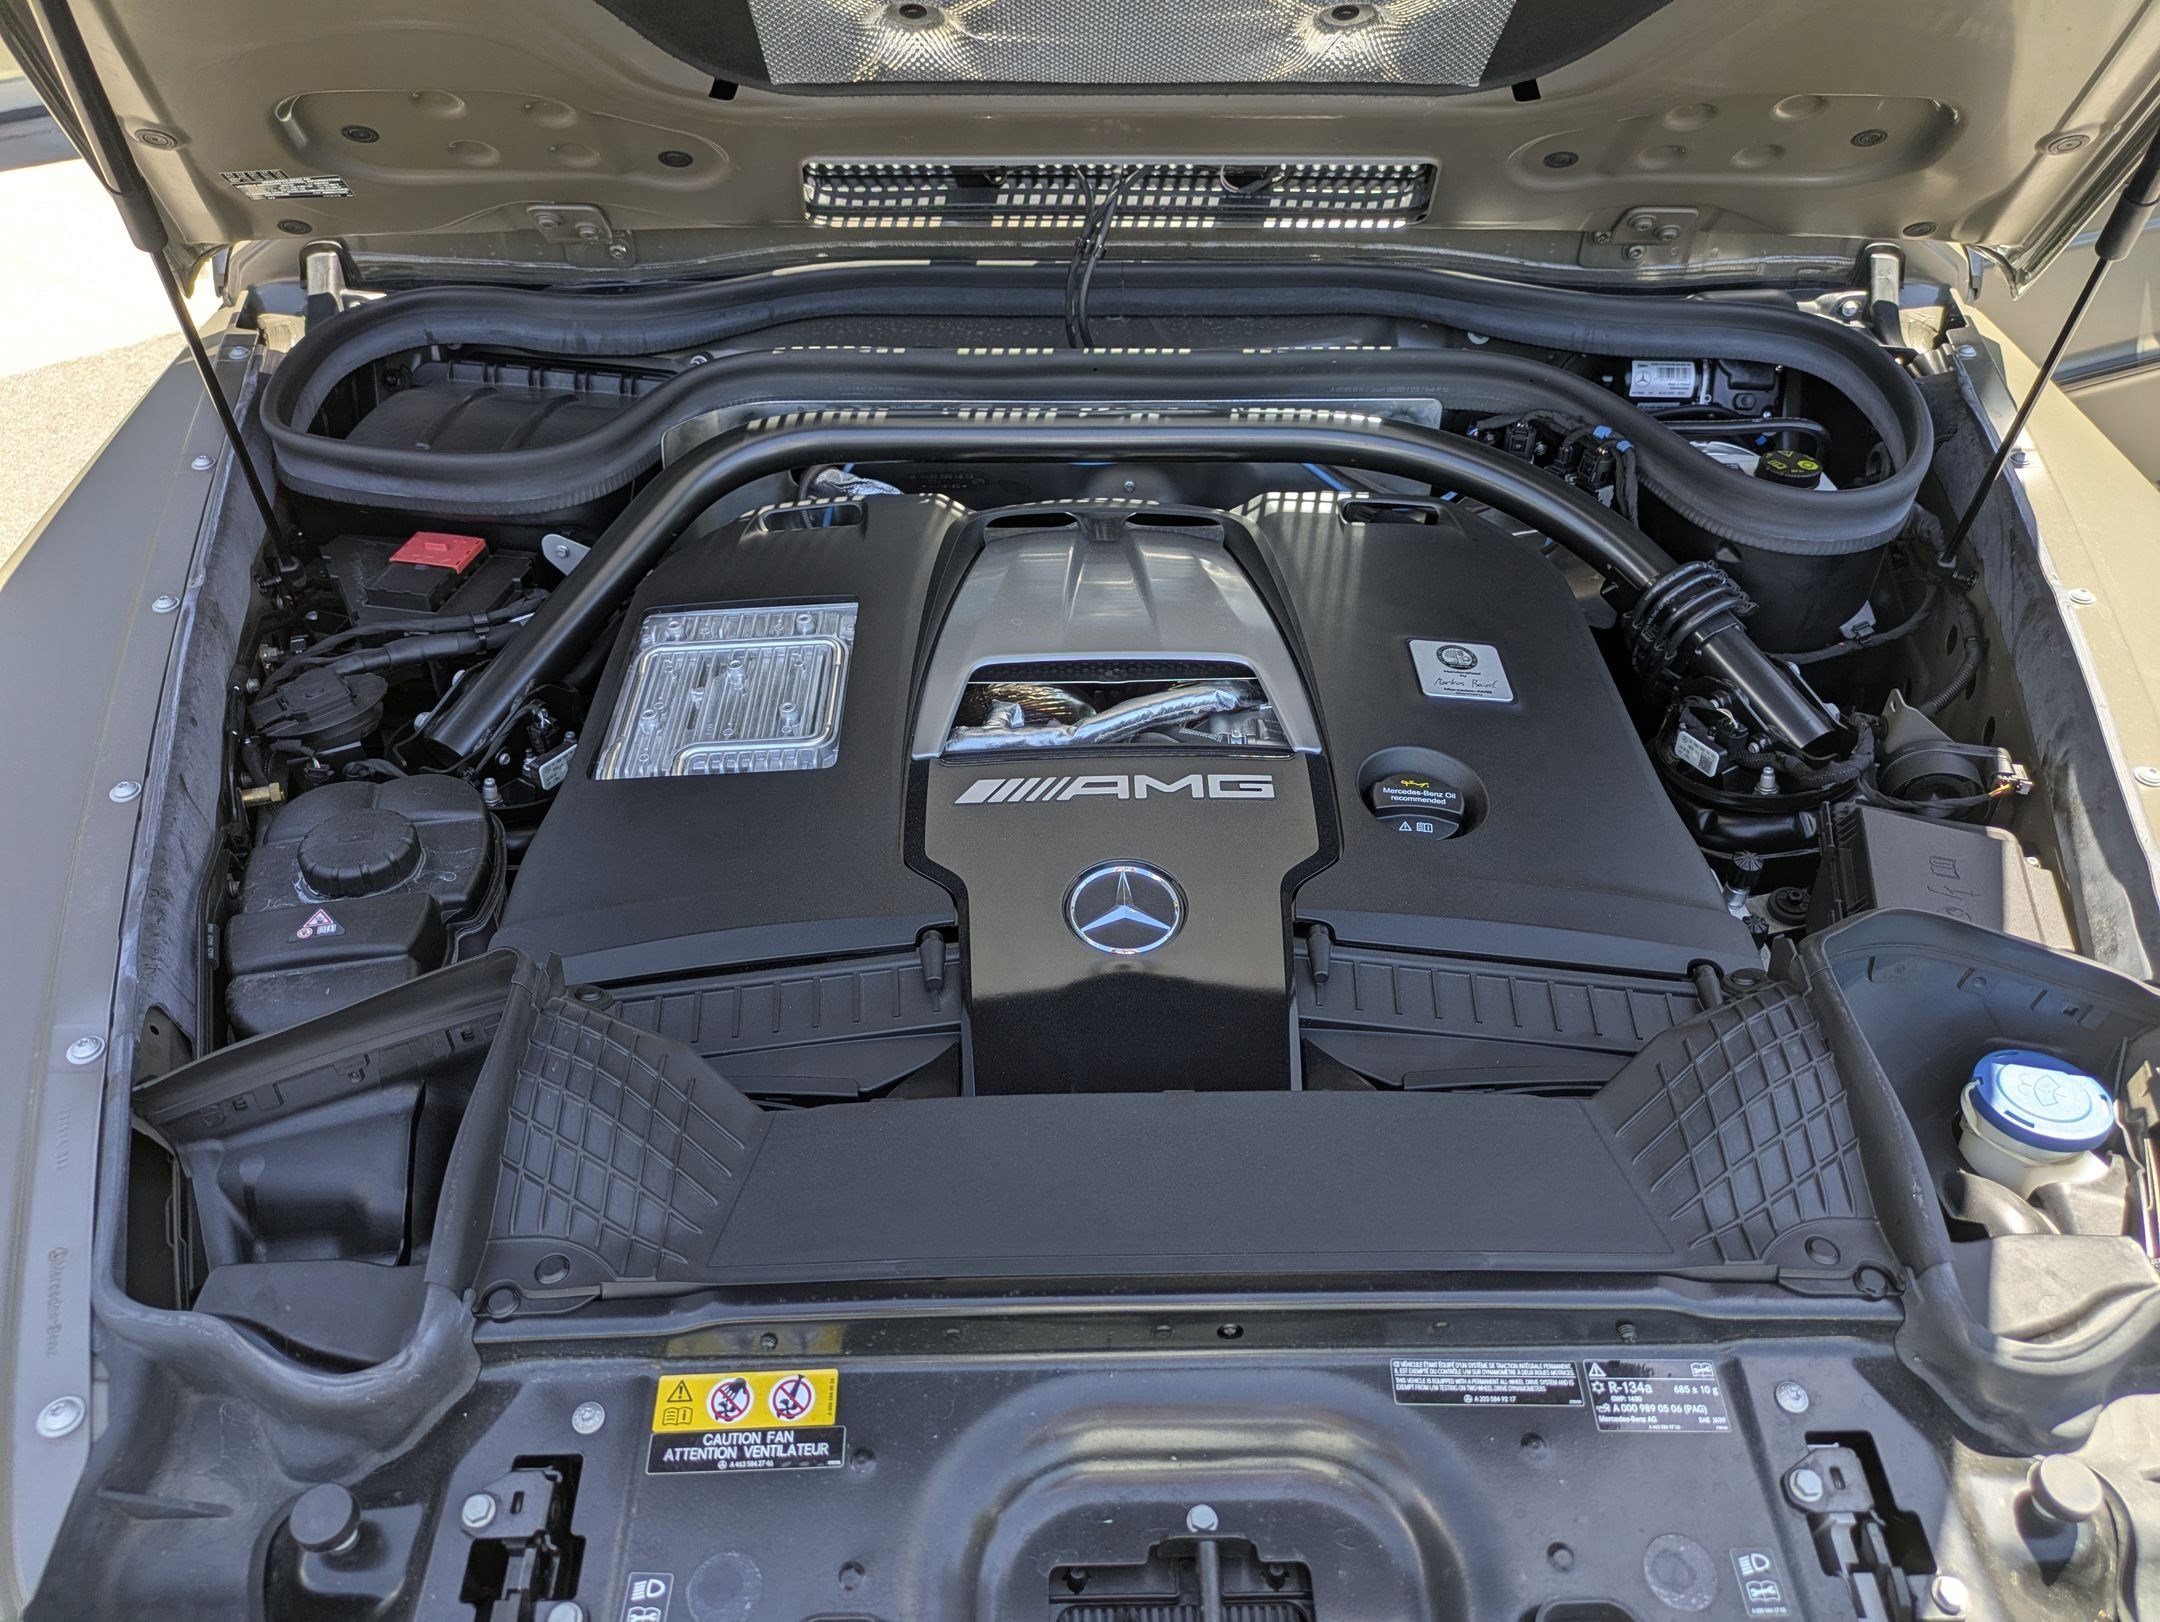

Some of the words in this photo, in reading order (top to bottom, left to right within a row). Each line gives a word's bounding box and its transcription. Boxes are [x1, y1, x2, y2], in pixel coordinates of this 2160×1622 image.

[1056, 774, 1275, 801] AMG
[1382, 787, 1443, 798] Mercedes-Benz
[1390, 795, 1446, 804] recommended
[1608, 1382, 1653, 1394] R-134a
[1674, 1385, 1690, 1394] 685
[1700, 1385, 1710, 1394] 10
[1712, 1387, 1719, 1396] g
[1639, 1404, 1656, 1412] 989
[1658, 1405, 1668, 1413] 05
[1671, 1405, 1682, 1413] 06
[1684, 1404, 1708, 1414] (PAG)
[703, 1432, 762, 1446] CAUTION
[766, 1430, 794, 1443] FAN
[663, 1446, 737, 1462] ATTENTION
[744, 1443, 830, 1458] VENTILATEUR
